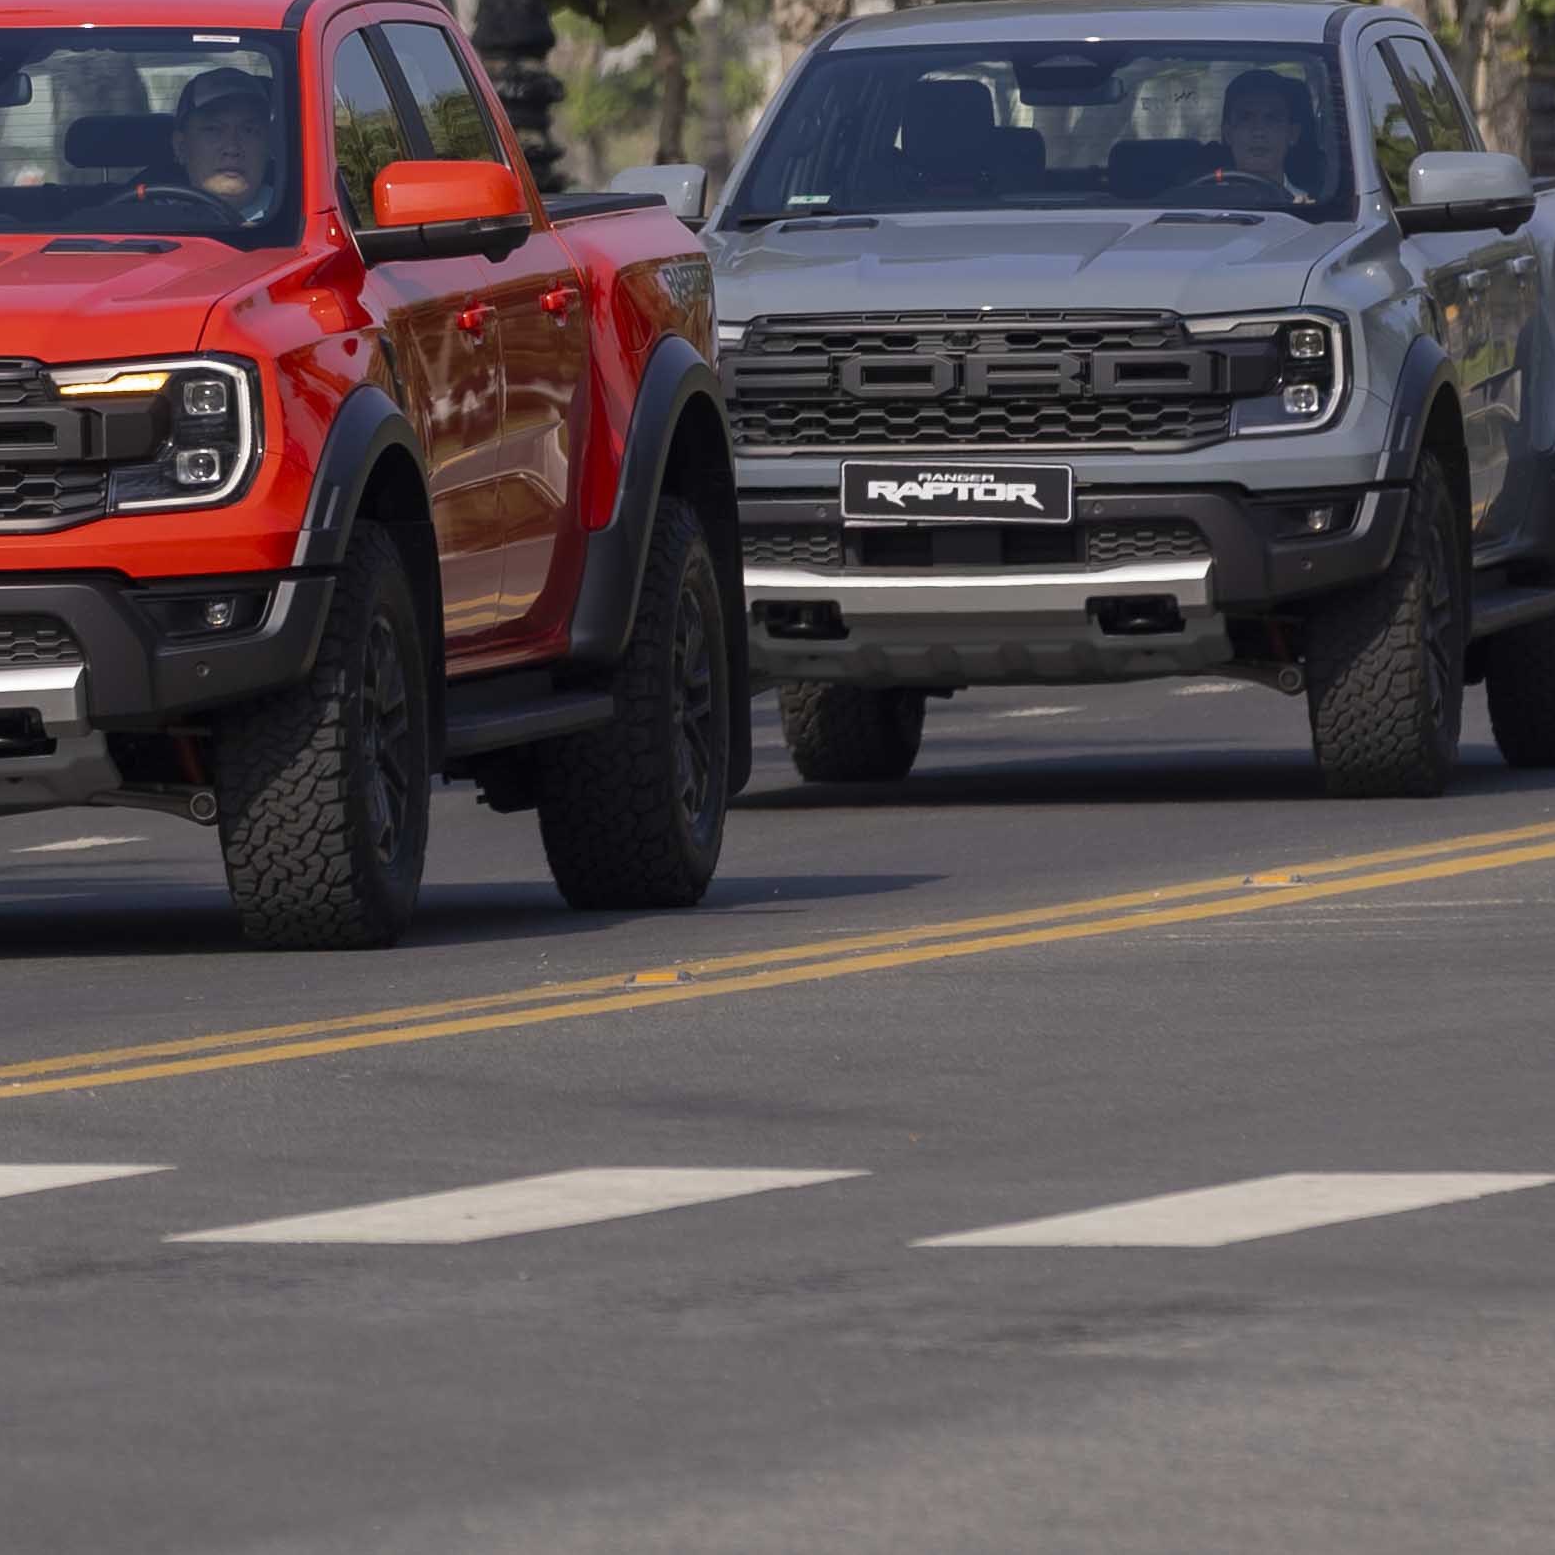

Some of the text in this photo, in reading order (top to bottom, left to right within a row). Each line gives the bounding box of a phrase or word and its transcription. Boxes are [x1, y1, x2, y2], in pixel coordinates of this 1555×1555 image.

[725, 350, 1211, 401] FORD
[918, 473, 995, 483] RANGER
[867, 480, 1045, 512] RAPTOR
